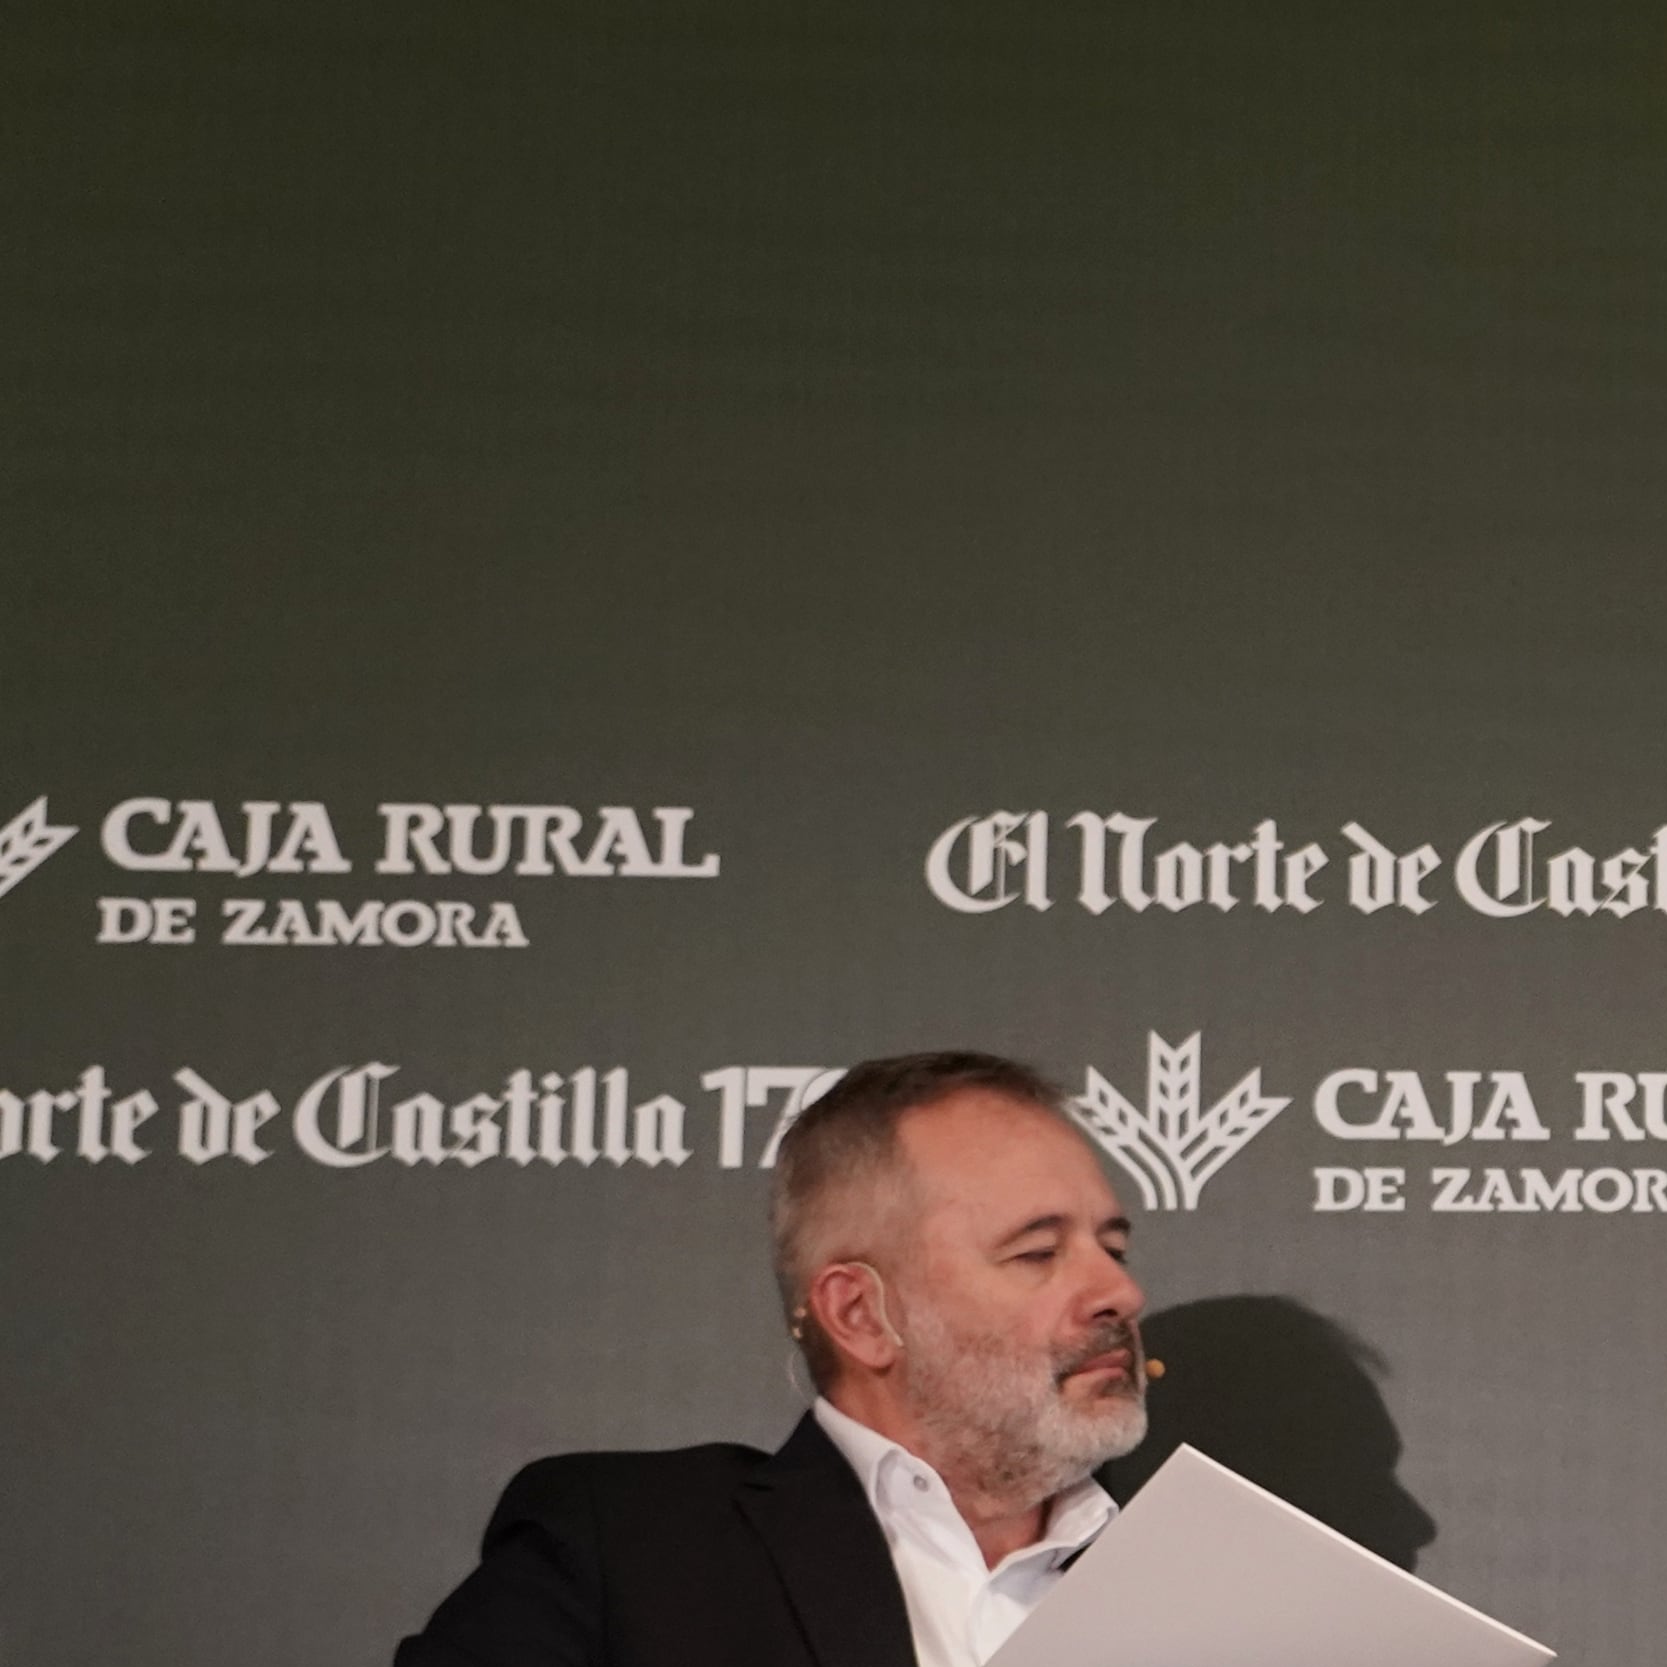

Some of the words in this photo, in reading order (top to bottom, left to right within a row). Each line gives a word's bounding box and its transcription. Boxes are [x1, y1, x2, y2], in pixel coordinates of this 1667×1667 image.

[101, 797, 352, 878] CAJA
[376, 803, 721, 878] RURAL
[925, 810, 1053, 913] El
[1066, 811, 1331, 915] Norte
[1341, 821, 1442, 915] de
[97, 897, 197, 944] DE
[222, 899, 530, 947] ZAMORA
[174, 1067, 281, 1165] de
[293, 1062, 692, 1168] Castilla
[701, 1065, 848, 1169] 17
[1313, 1068, 1551, 1146] CAJA
[1313, 1167, 1406, 1212] DE
